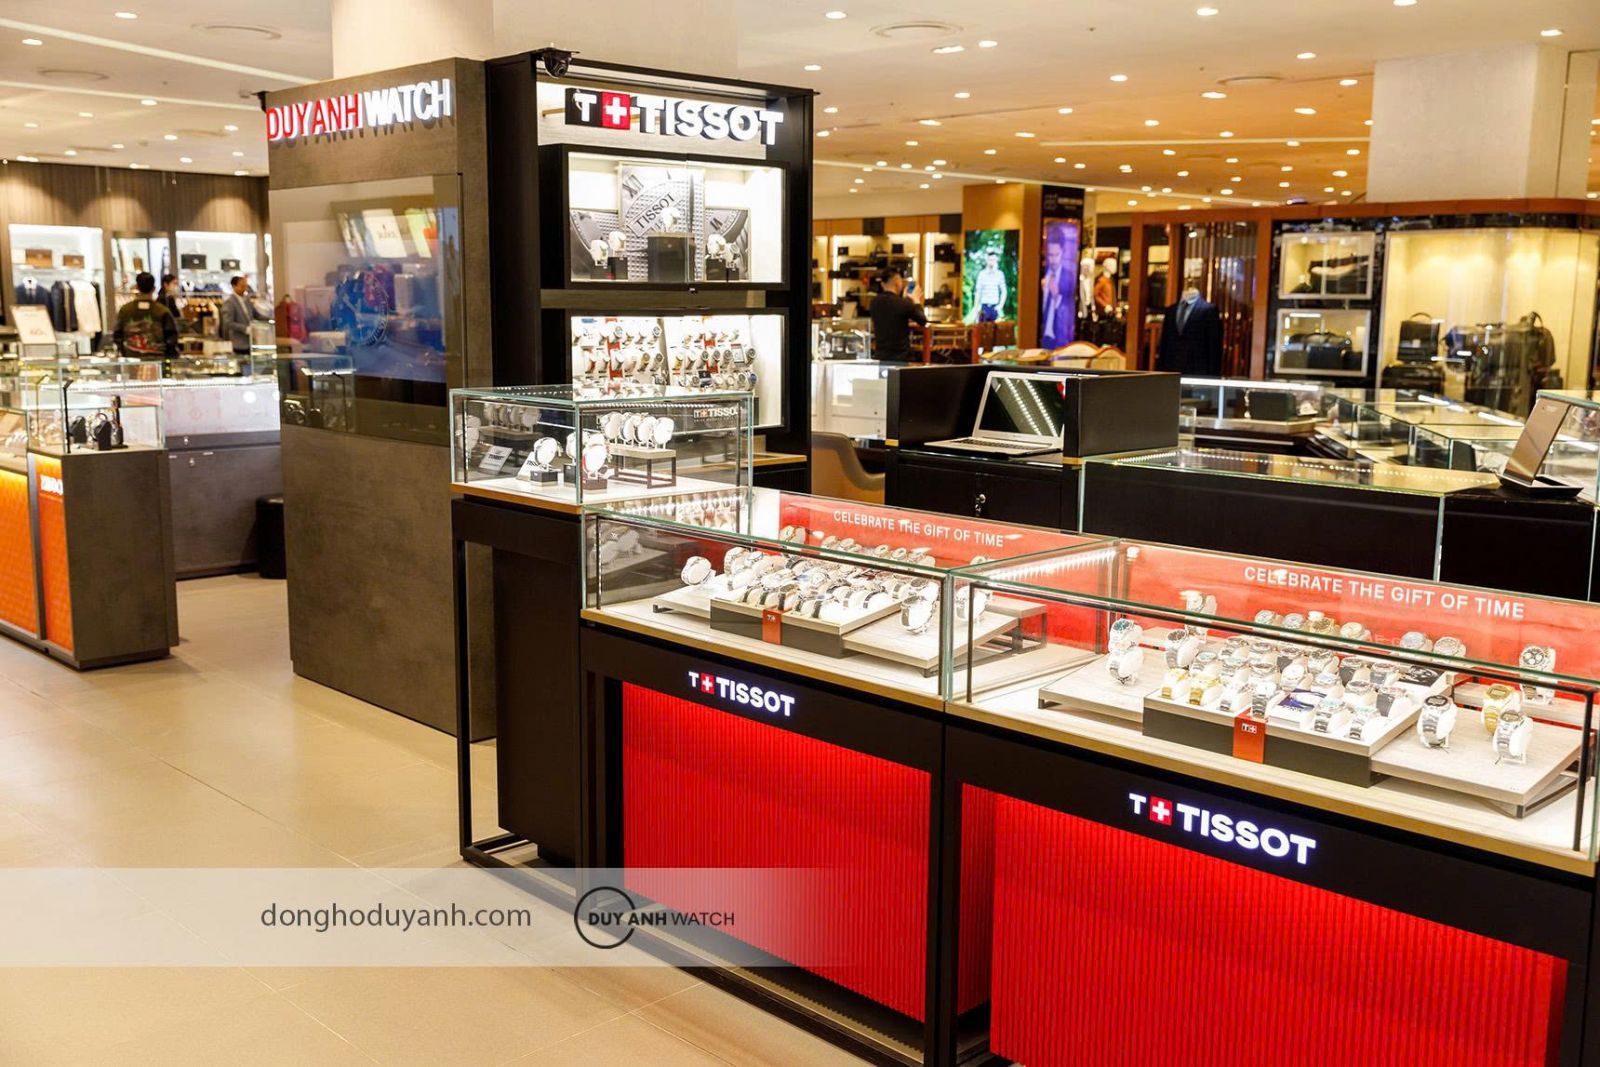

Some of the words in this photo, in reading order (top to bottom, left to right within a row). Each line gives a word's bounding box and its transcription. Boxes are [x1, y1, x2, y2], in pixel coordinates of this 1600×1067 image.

[363, 78, 451, 127] WATCH
[635, 97, 784, 146] TISSOT
[635, 192, 675, 229] TISSOT
[833, 510, 895, 531] CELEBRATE
[898, 519, 920, 535] THE
[923, 522, 951, 539] GIFT
[953, 527, 971, 543] OF
[974, 531, 1004, 548] TIME
[1244, 566, 1343, 593] CELEBRATE
[1349, 581, 1385, 600] THE
[1391, 586, 1435, 606] GIFT
[1440, 592, 1468, 610] OF
[1476, 597, 1525, 619] TIME
[716, 676, 795, 717] TISSOT
[1176, 802, 1316, 865] TISSOT
